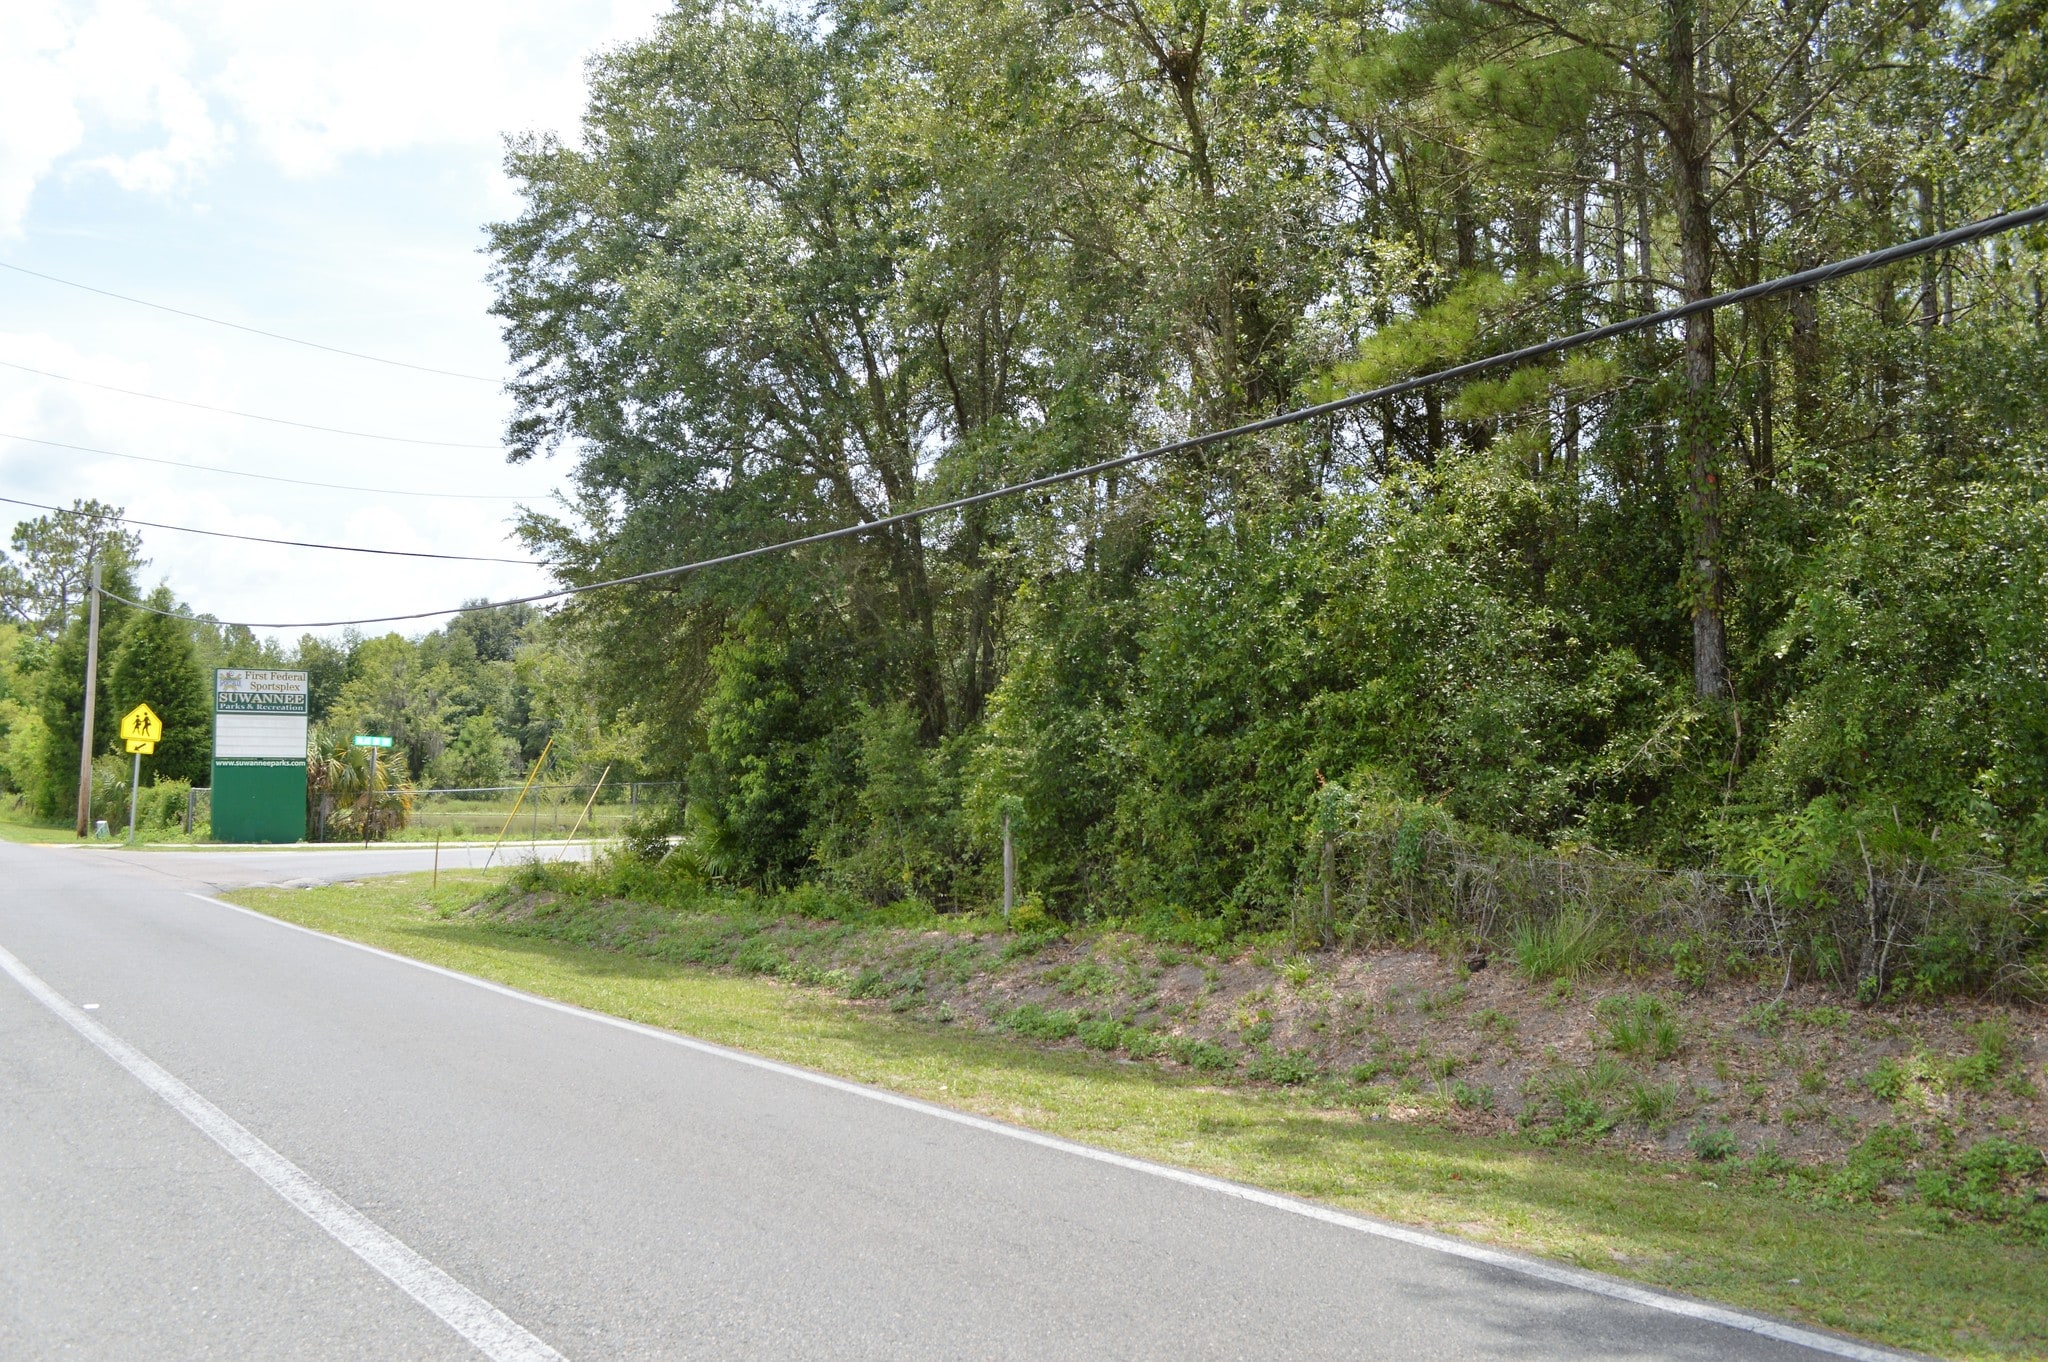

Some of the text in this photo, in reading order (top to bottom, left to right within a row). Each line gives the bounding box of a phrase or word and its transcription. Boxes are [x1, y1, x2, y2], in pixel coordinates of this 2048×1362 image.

[245, 671, 306, 681] First Federal
[250, 681, 301, 692] Sportsplex
[219, 692, 305, 705] SUWANNEE
[215, 759, 306, 767] www.suwanneeparks.com
